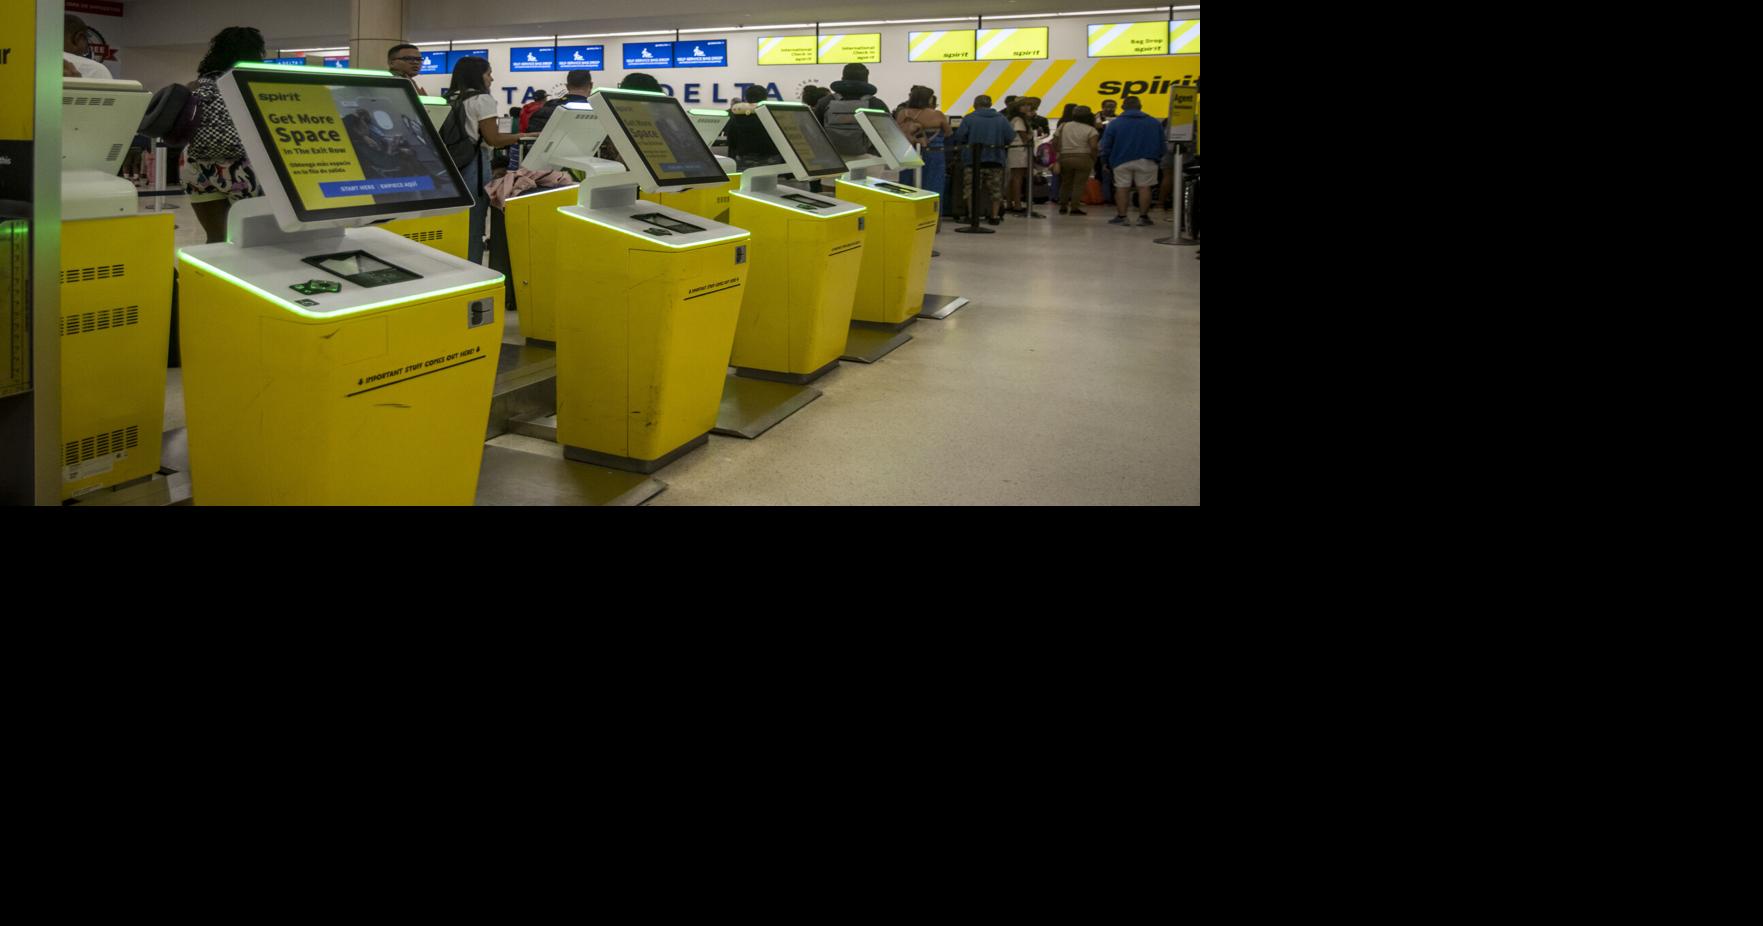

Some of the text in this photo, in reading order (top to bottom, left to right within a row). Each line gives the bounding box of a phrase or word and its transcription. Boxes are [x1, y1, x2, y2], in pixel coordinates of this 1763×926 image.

[259, 92, 300, 102] spirit
[268, 113, 335, 124] Get More
[275, 127, 342, 146] Space
[365, 368, 403, 384] IMPORTANT
[404, 362, 423, 373] STUFF
[424, 356, 445, 367] COMES
[446, 352, 459, 361] OUT
